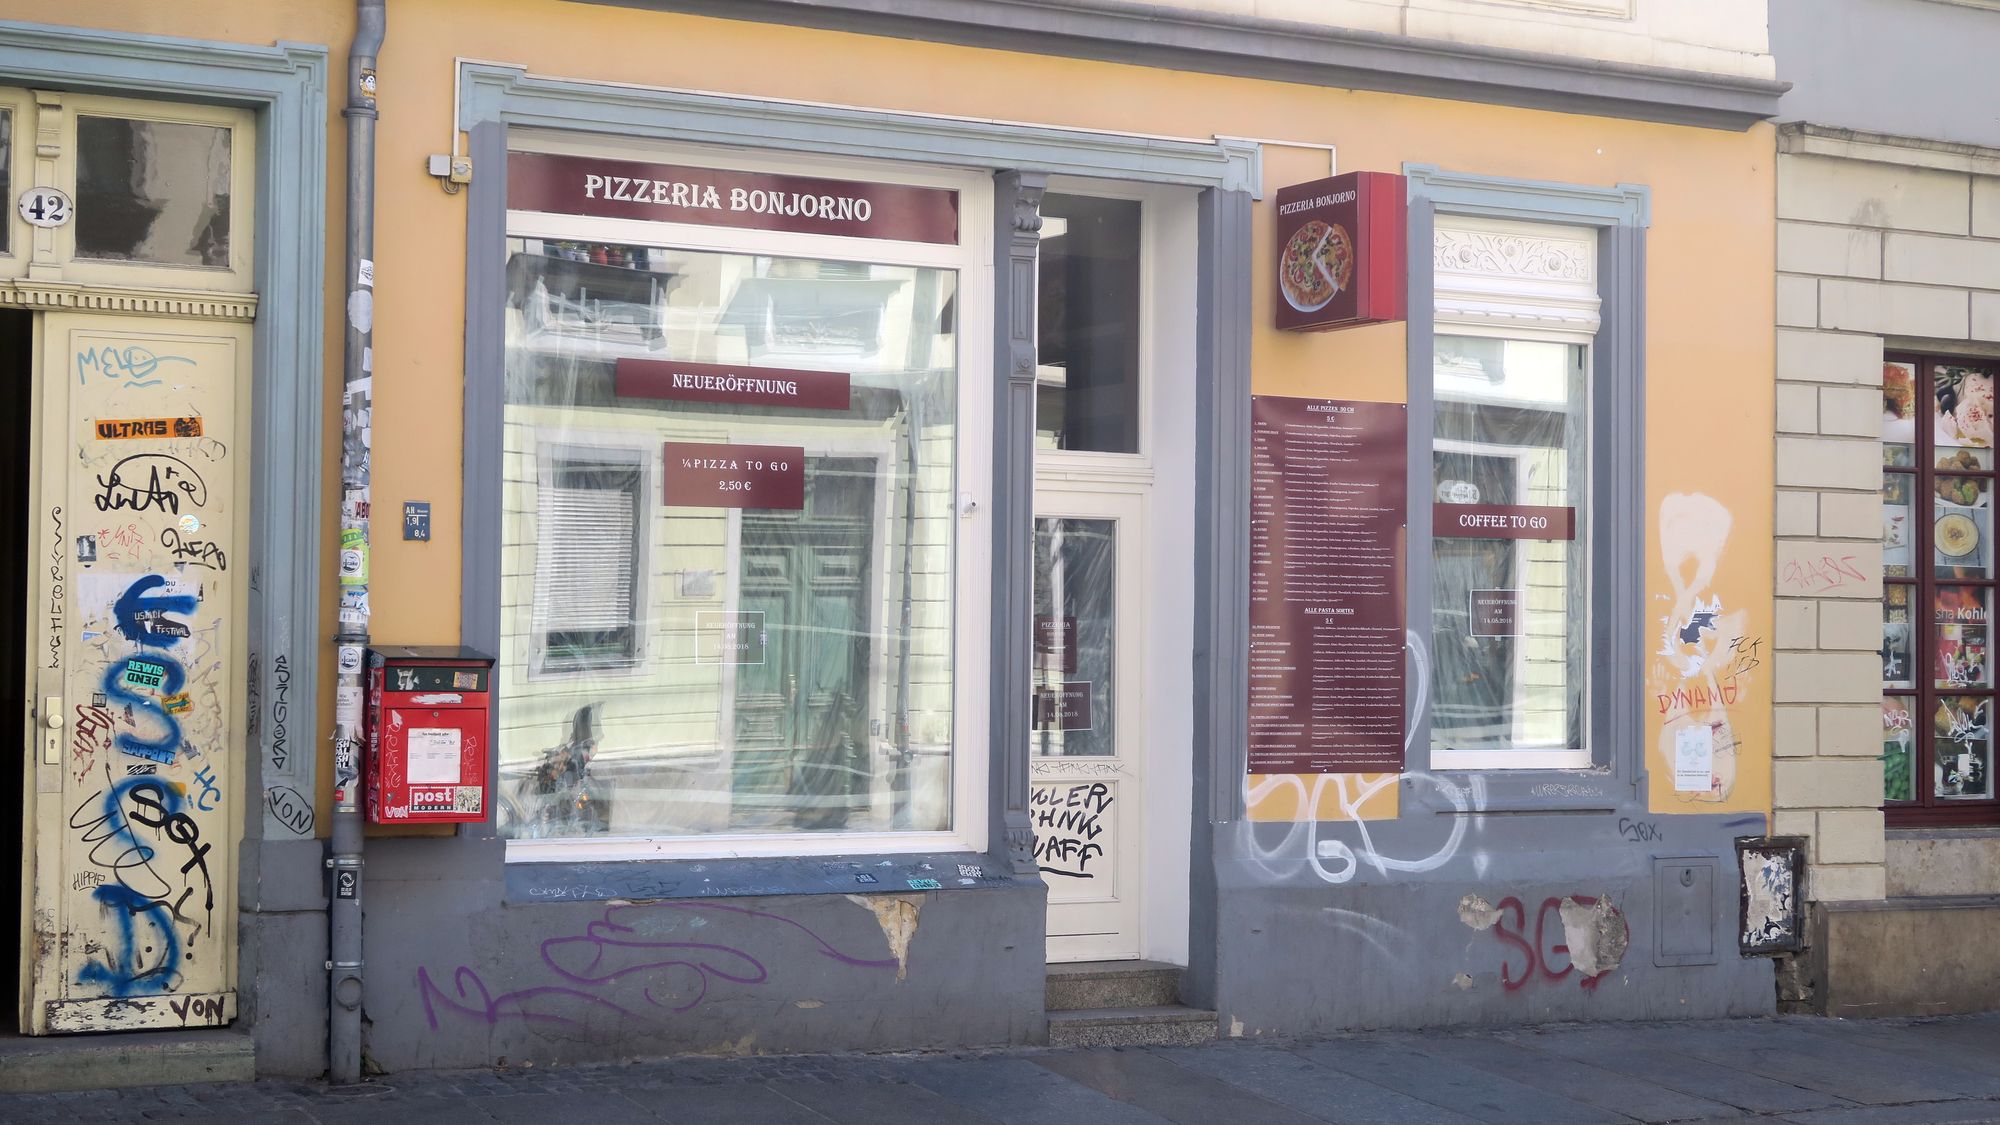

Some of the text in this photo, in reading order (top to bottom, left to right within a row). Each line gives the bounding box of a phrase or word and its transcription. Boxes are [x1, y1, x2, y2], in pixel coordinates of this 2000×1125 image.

[28, 194, 64, 221] 42
[584, 174, 873, 223] PIZZERIA BONJORNO
[1280, 190, 1357, 216] PIZZERIA BONJORNO
[671, 372, 798, 396] NEUERÖFFNUNG
[98, 420, 168, 439] ULTRAS
[745, 461, 763, 470] TO
[770, 461, 788, 472] GO
[718, 480, 752, 491] 2,50 €
[1459, 514, 1547, 529] COFFEE TO GO
[127, 672, 160, 687] BEND
[413, 788, 452, 807] post
[269, 789, 311, 831] VON
[169, 995, 226, 1027] VON
